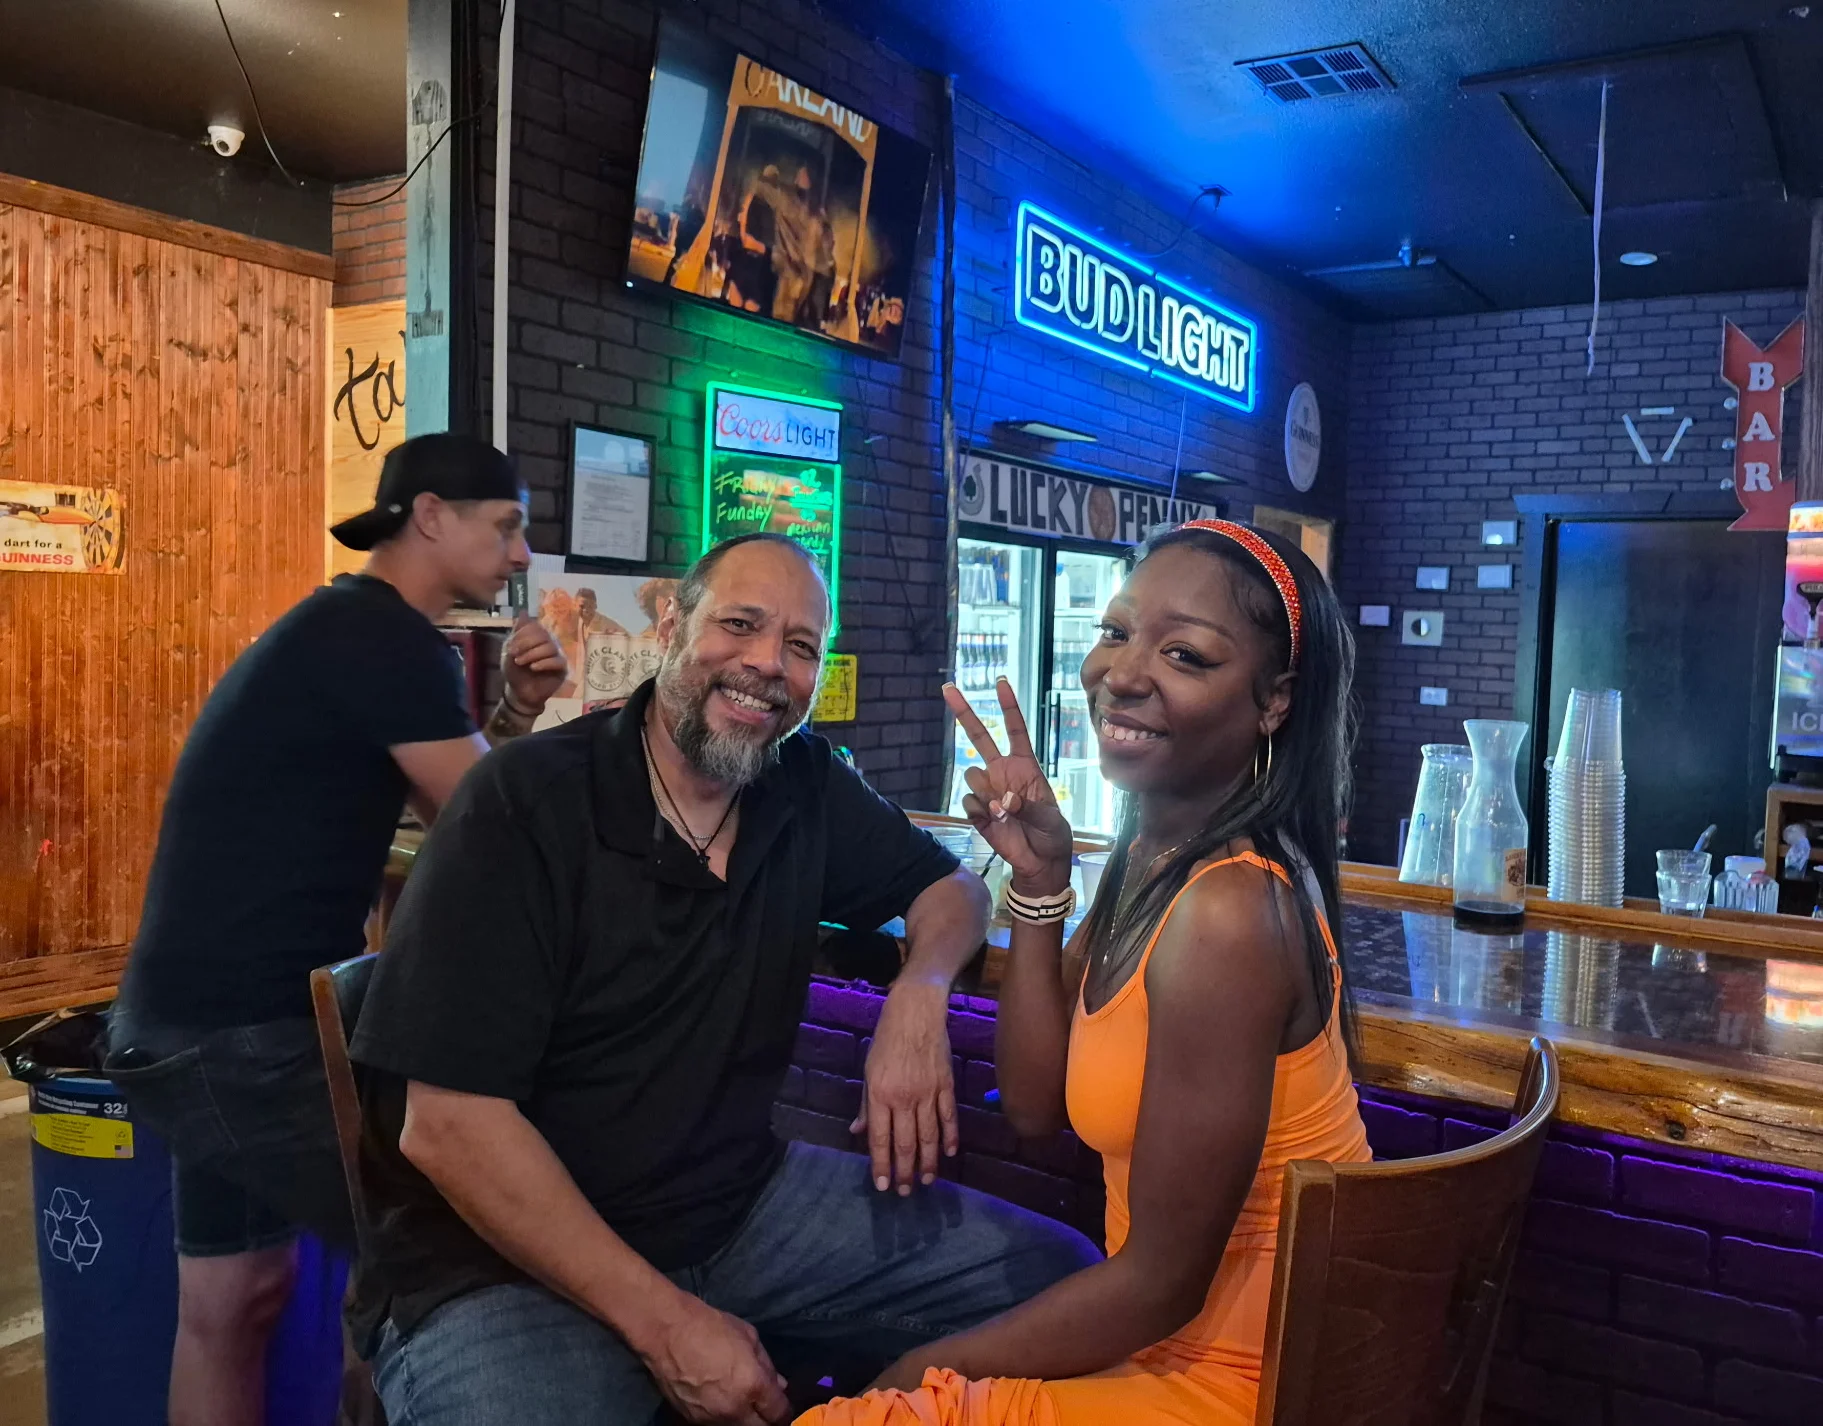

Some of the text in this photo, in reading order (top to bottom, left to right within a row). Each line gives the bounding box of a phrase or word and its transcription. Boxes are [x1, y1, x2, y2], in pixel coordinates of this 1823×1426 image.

[1026, 222, 1250, 393] BUD LIGHT
[719, 403, 836, 450] Coors LIGHT
[1742, 362, 1776, 492] BAR
[990, 463, 1090, 536] LUCKY
[0, 552, 74, 566] UINNESS
[4, 538, 30, 548] dart
[34, 538, 52, 549] for
[1792, 711, 1823, 732] IC
[103, 1102, 123, 1115] 32
